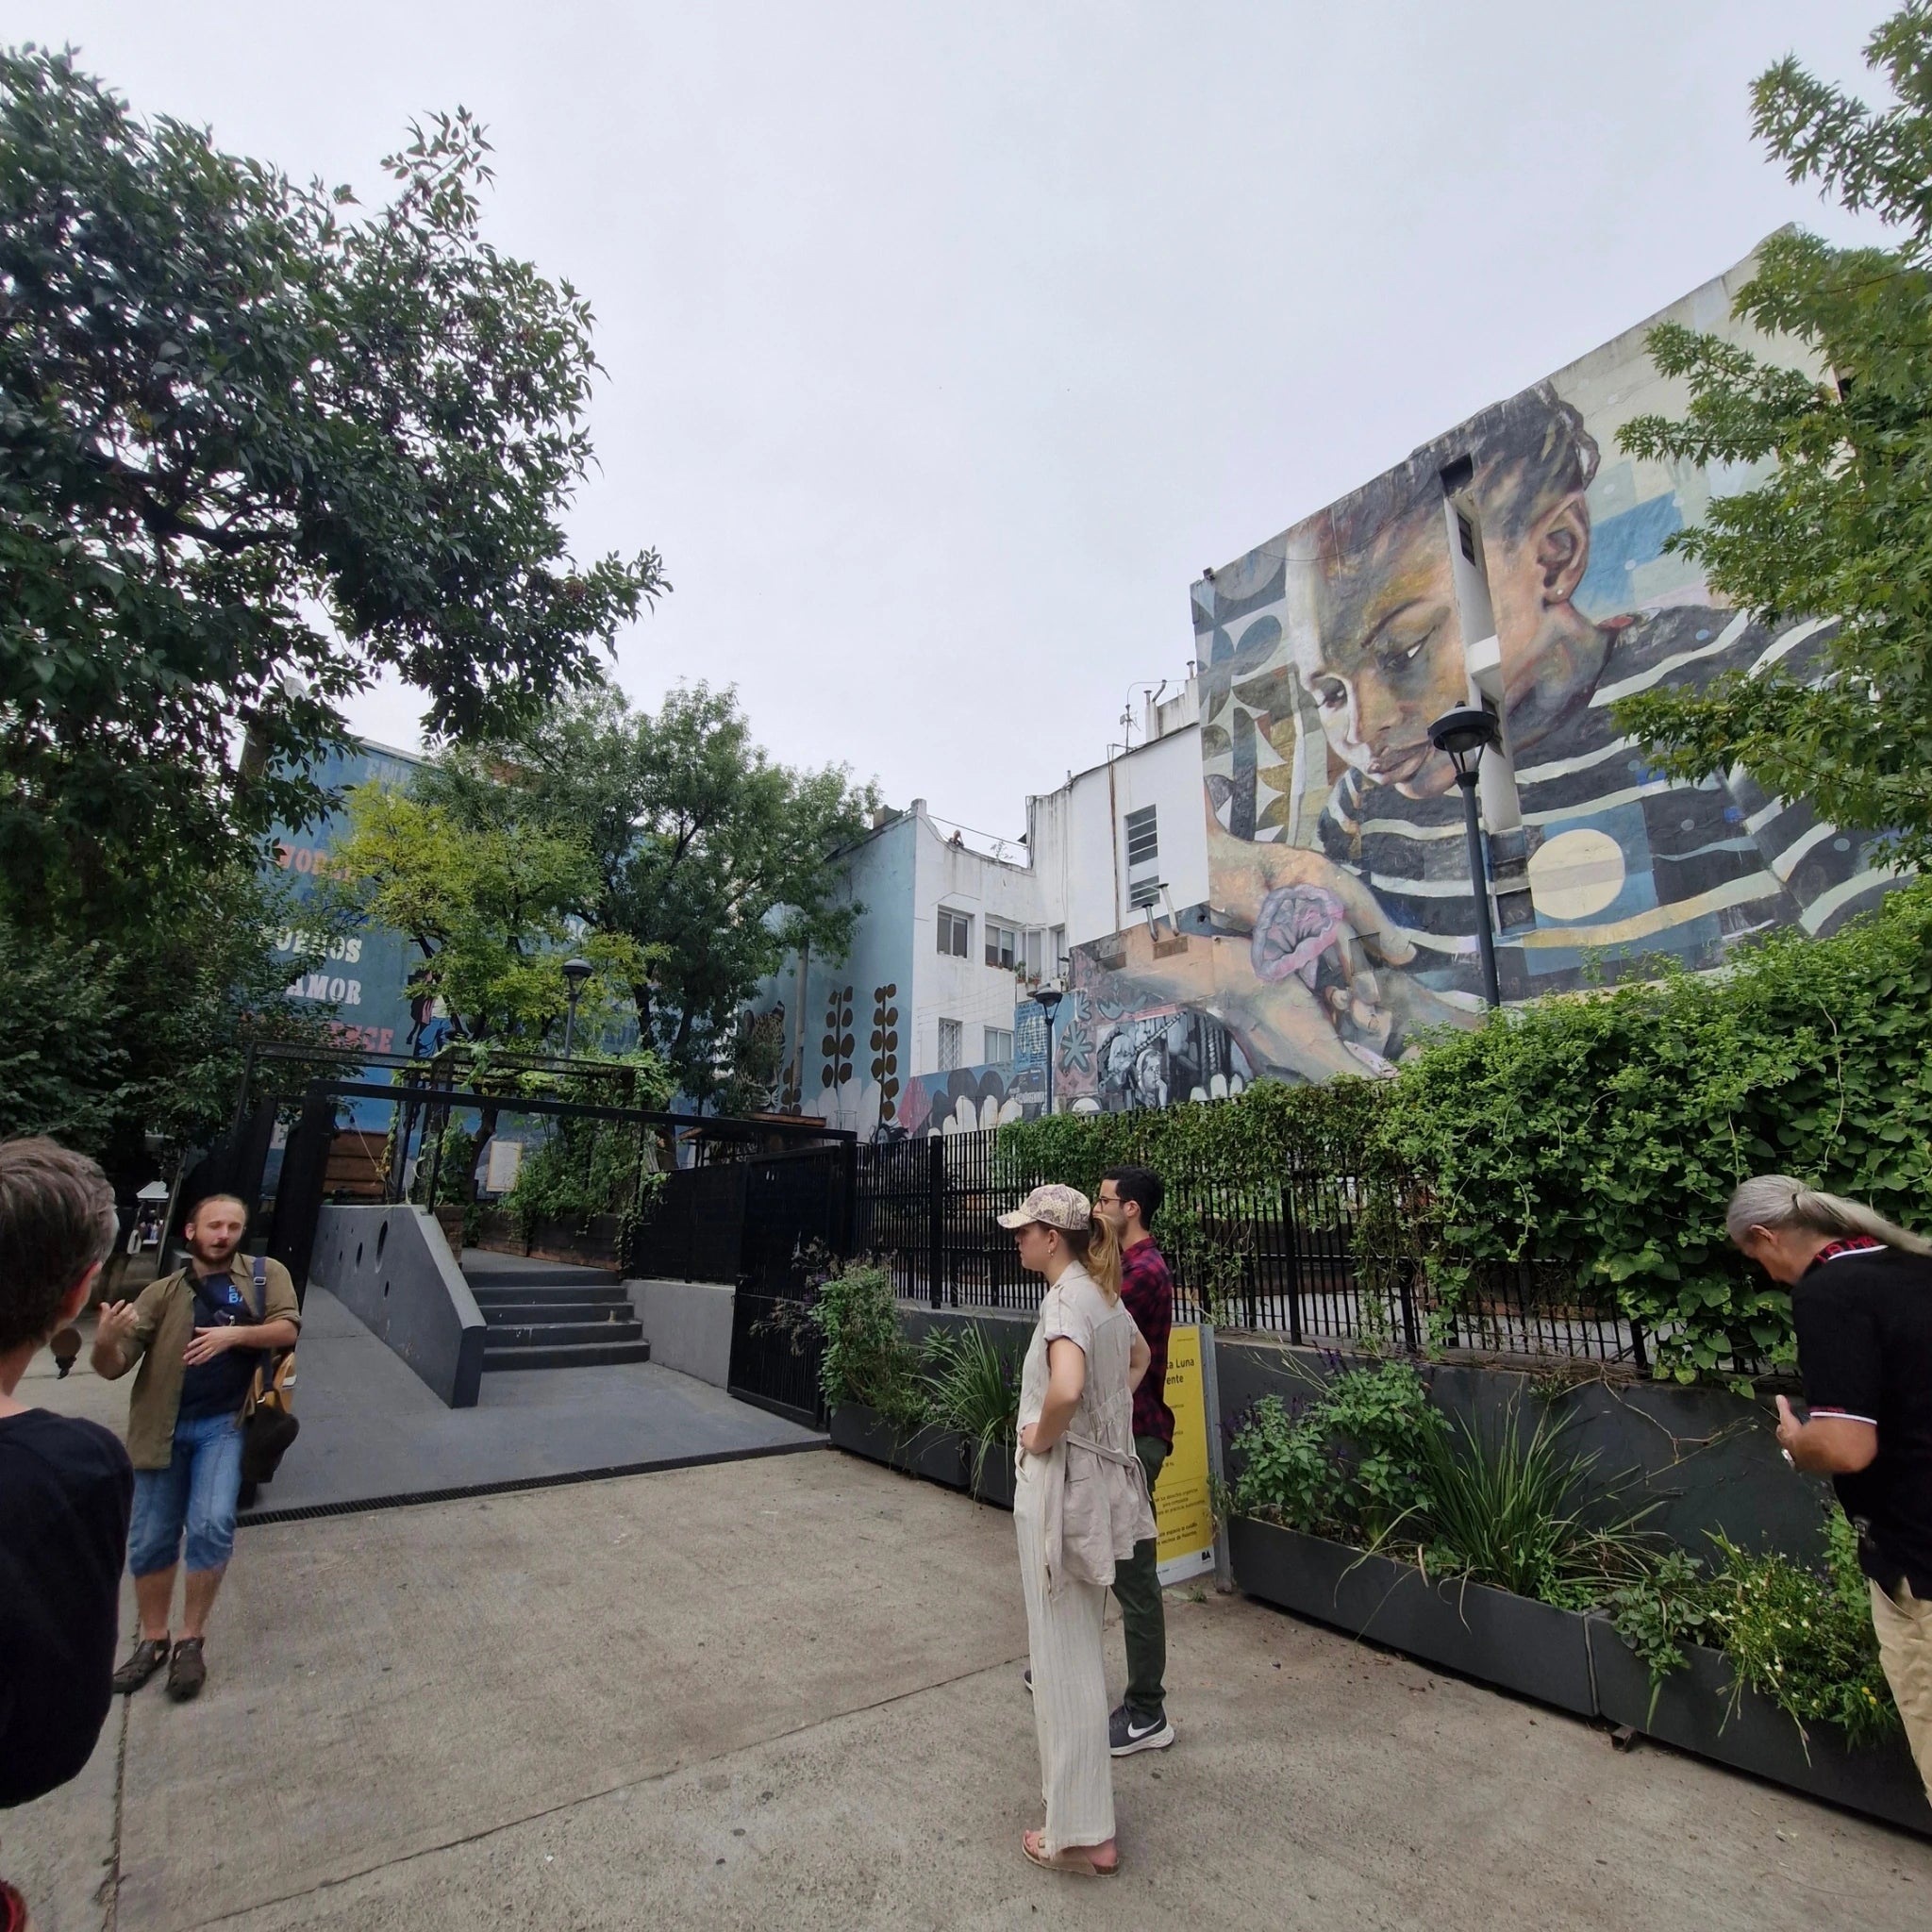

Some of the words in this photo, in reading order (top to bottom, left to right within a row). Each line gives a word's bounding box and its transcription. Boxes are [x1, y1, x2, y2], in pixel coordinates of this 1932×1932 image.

[285, 974, 361, 1005] AMOR
[1175, 1358, 1194, 1368] Luna
[1166, 1374, 1184, 1385] ente
[1202, 1550, 1211, 1561] BA
